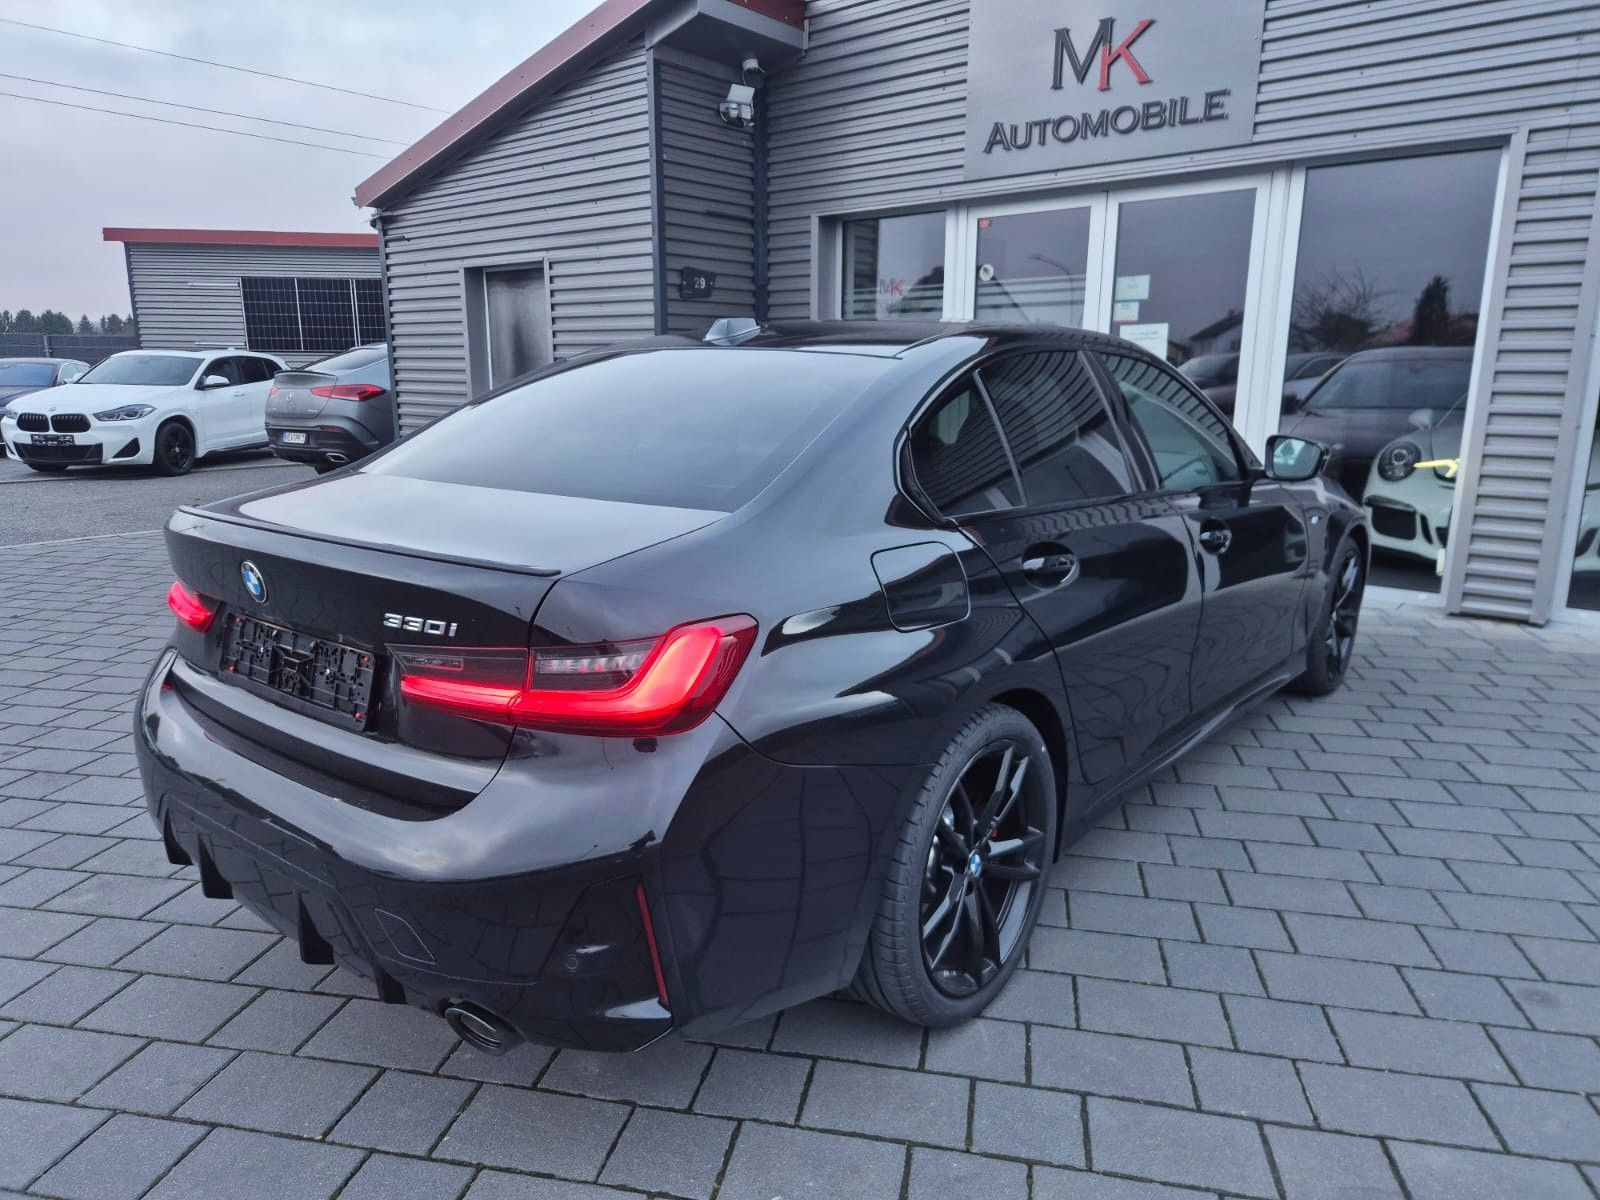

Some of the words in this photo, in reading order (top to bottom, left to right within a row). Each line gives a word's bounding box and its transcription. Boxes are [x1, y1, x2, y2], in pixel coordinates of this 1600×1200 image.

[1051, 17, 1155, 91] MK
[983, 88, 1231, 154] AUTOMOBILE
[694, 276, 706, 289] 29
[383, 612, 458, 637] 330i
